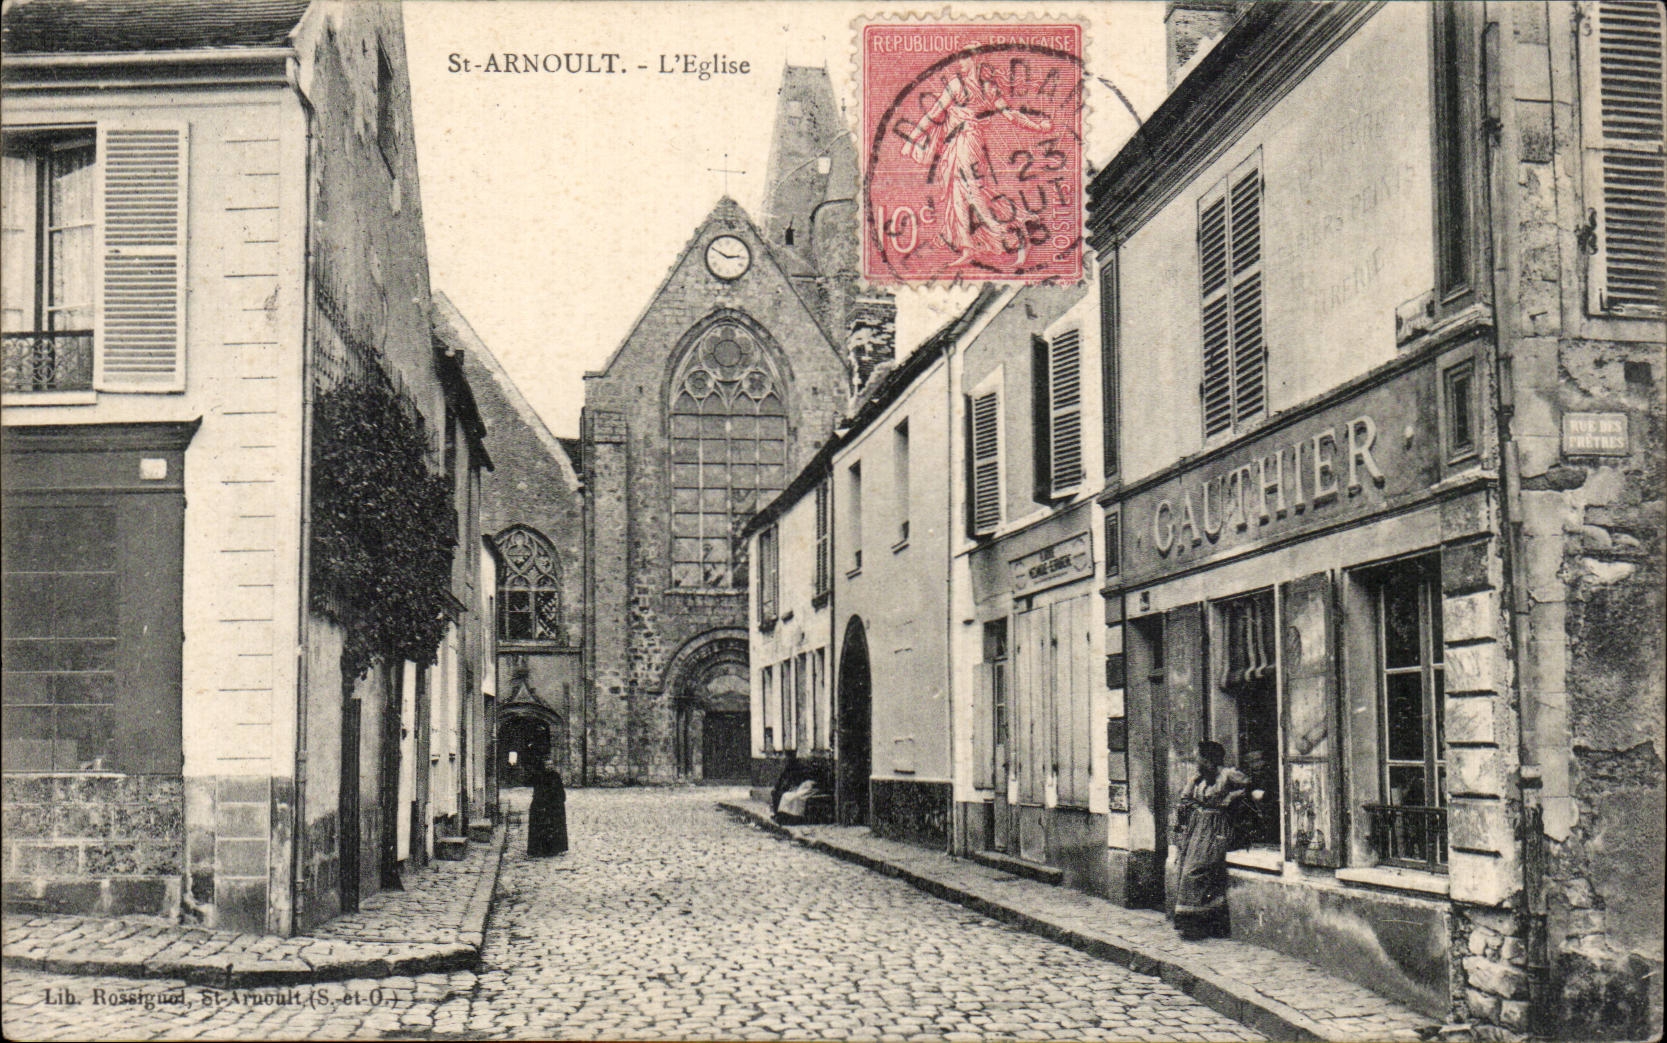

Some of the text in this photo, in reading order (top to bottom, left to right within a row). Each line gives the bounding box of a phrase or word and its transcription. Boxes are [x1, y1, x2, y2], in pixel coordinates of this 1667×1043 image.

[1008, 138, 1067, 182] 23
[1570, 420, 1622, 434] RUE DES
[1155, 415, 1384, 556] GAUTHIER
